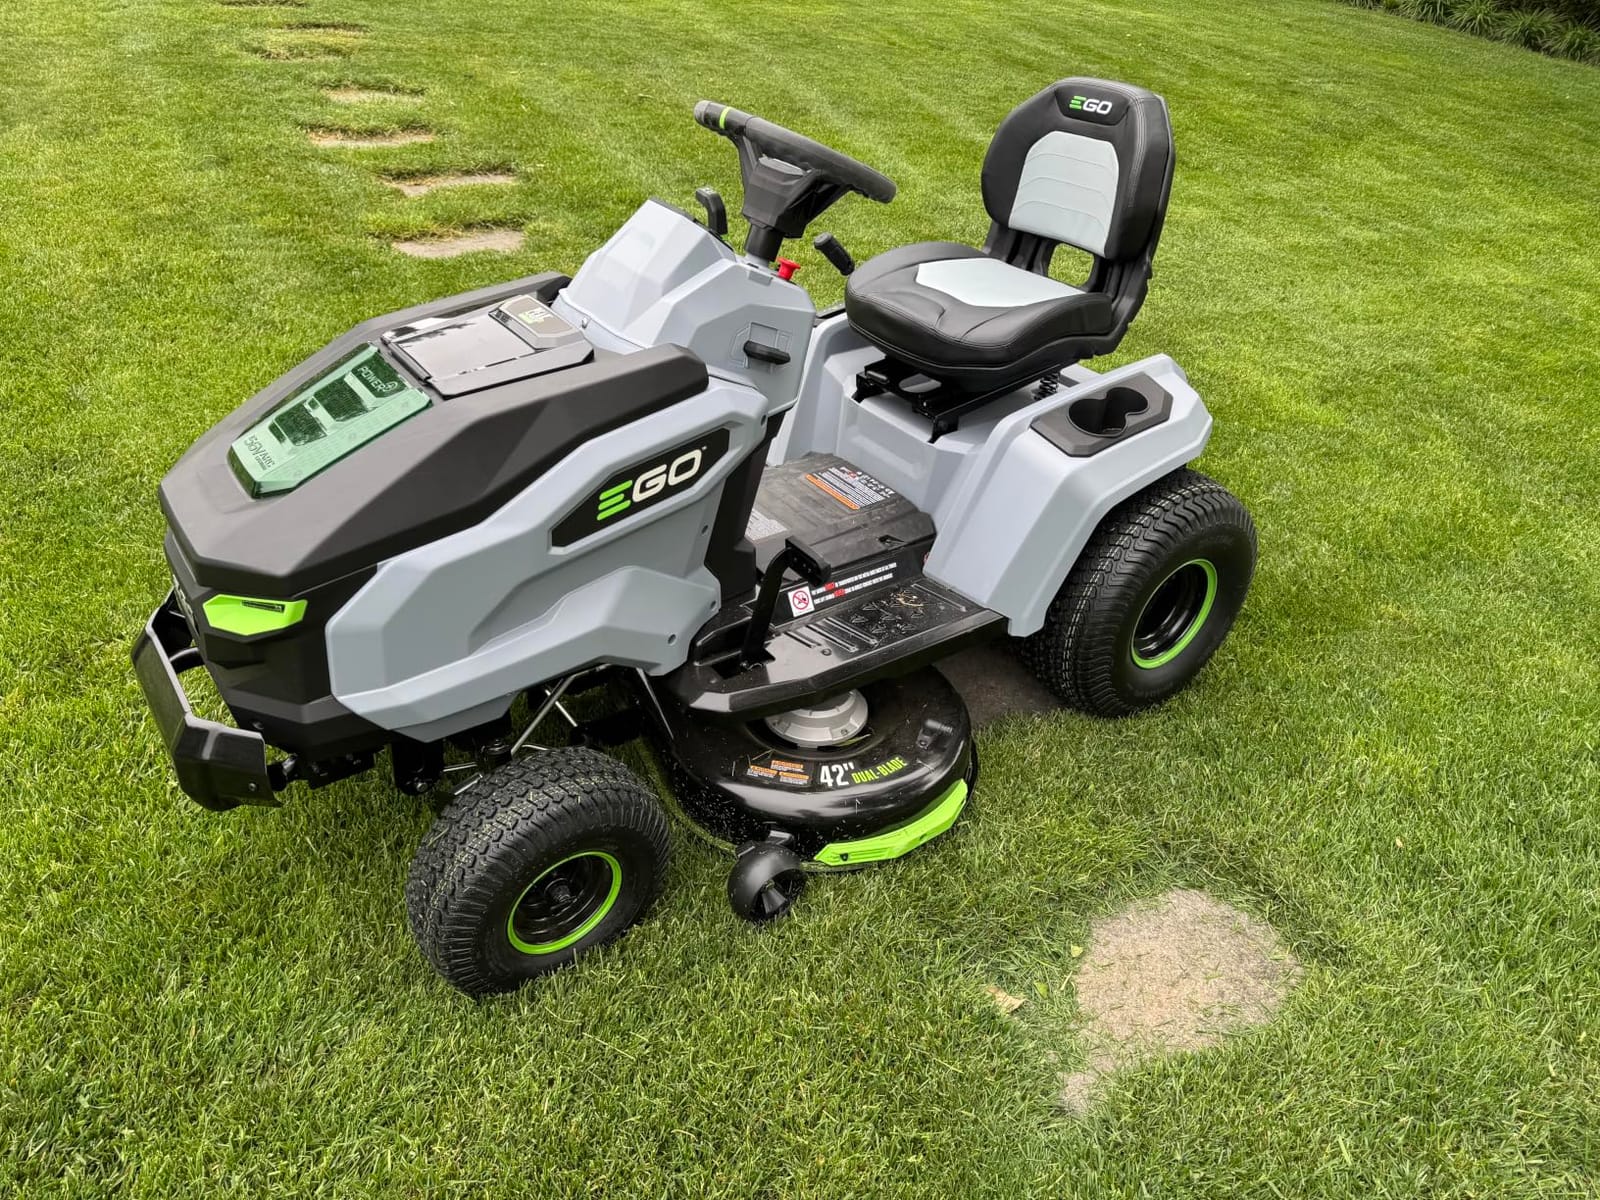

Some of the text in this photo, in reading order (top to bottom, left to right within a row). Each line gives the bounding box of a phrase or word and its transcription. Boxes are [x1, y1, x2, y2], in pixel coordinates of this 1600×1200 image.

[1069, 95, 1113, 115] EGO
[596, 449, 702, 521] EGO
[819, 762, 855, 787] 42"
[851, 756, 908, 784] DUAL-BLADE
